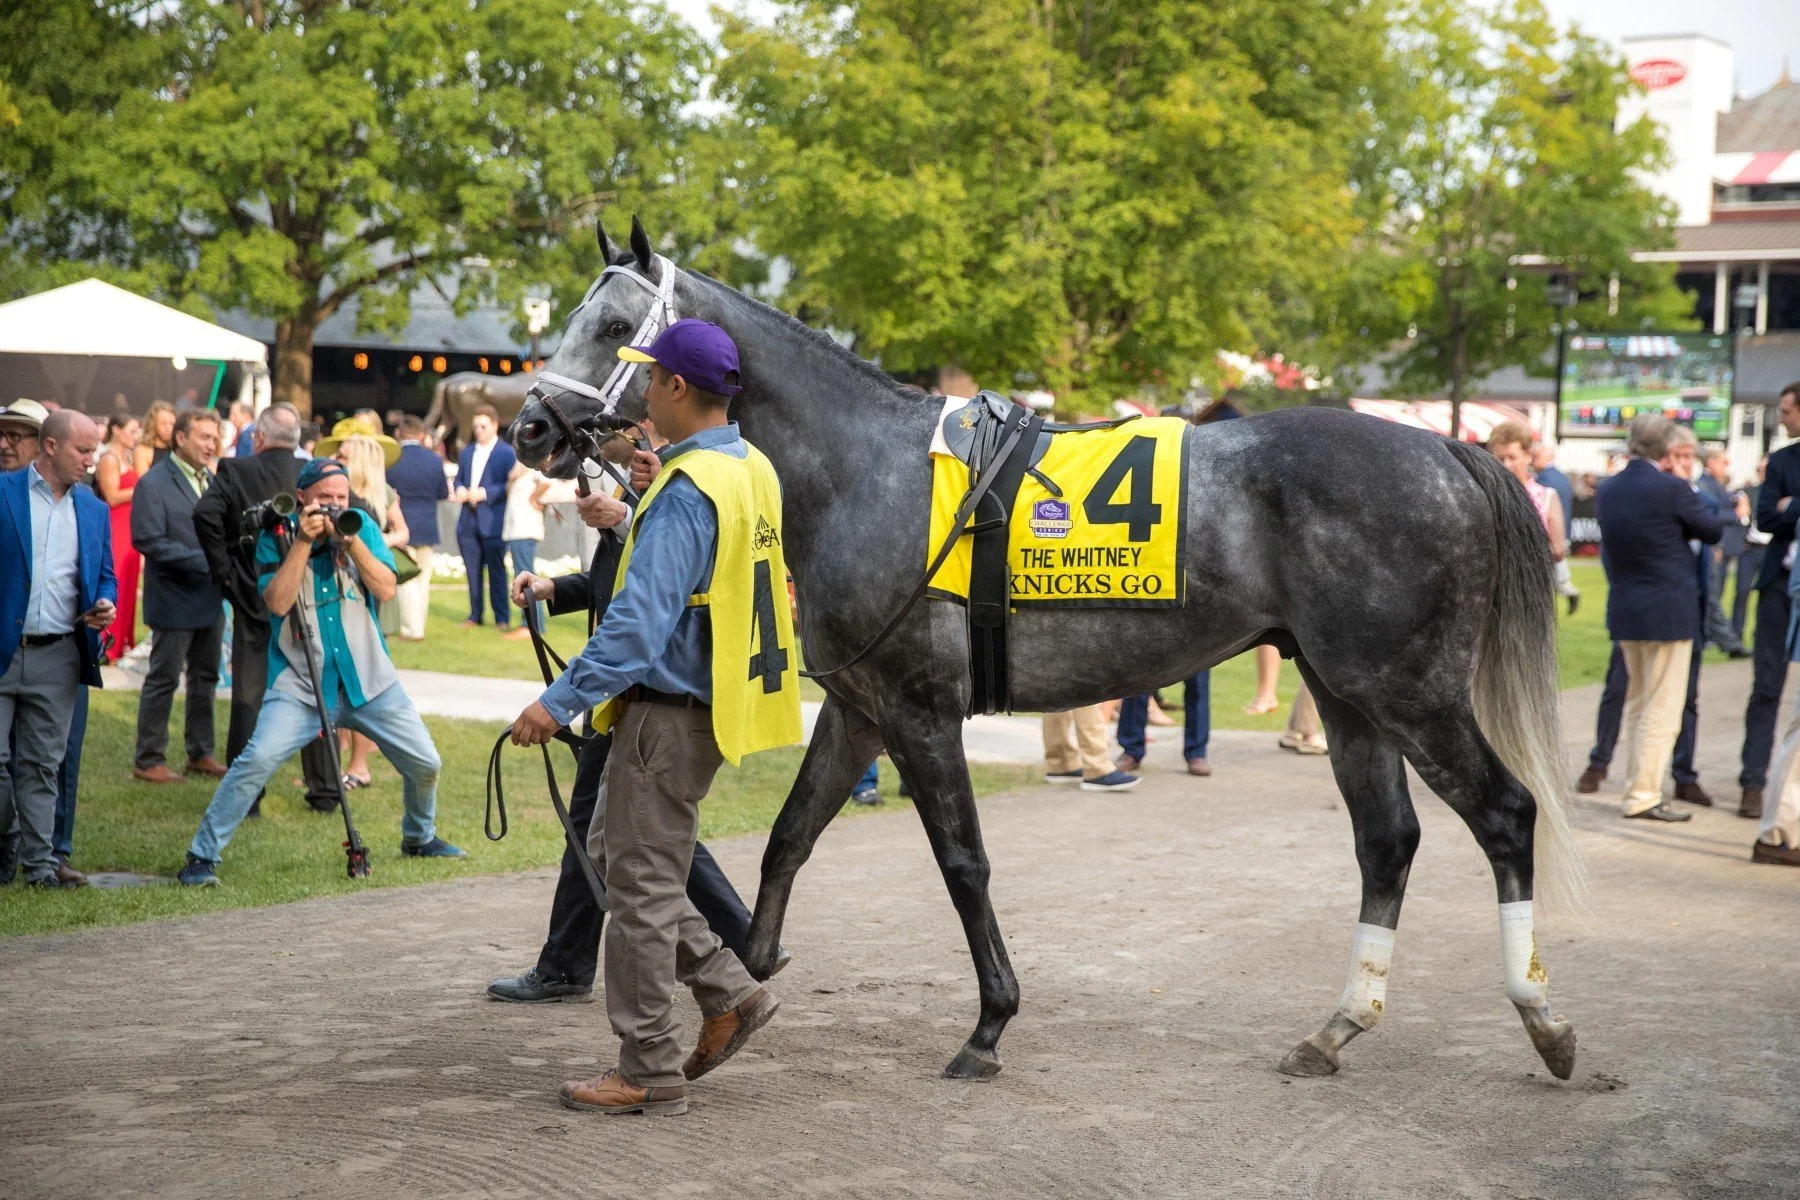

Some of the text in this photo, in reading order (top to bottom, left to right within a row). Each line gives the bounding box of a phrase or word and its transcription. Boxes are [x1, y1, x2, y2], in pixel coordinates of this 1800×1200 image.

[1082, 434, 1162, 543] 4
[1010, 574, 1162, 595] KNICKS GO
[1021, 547, 1142, 569] THE WHITNEY
[748, 558, 789, 695] 4
